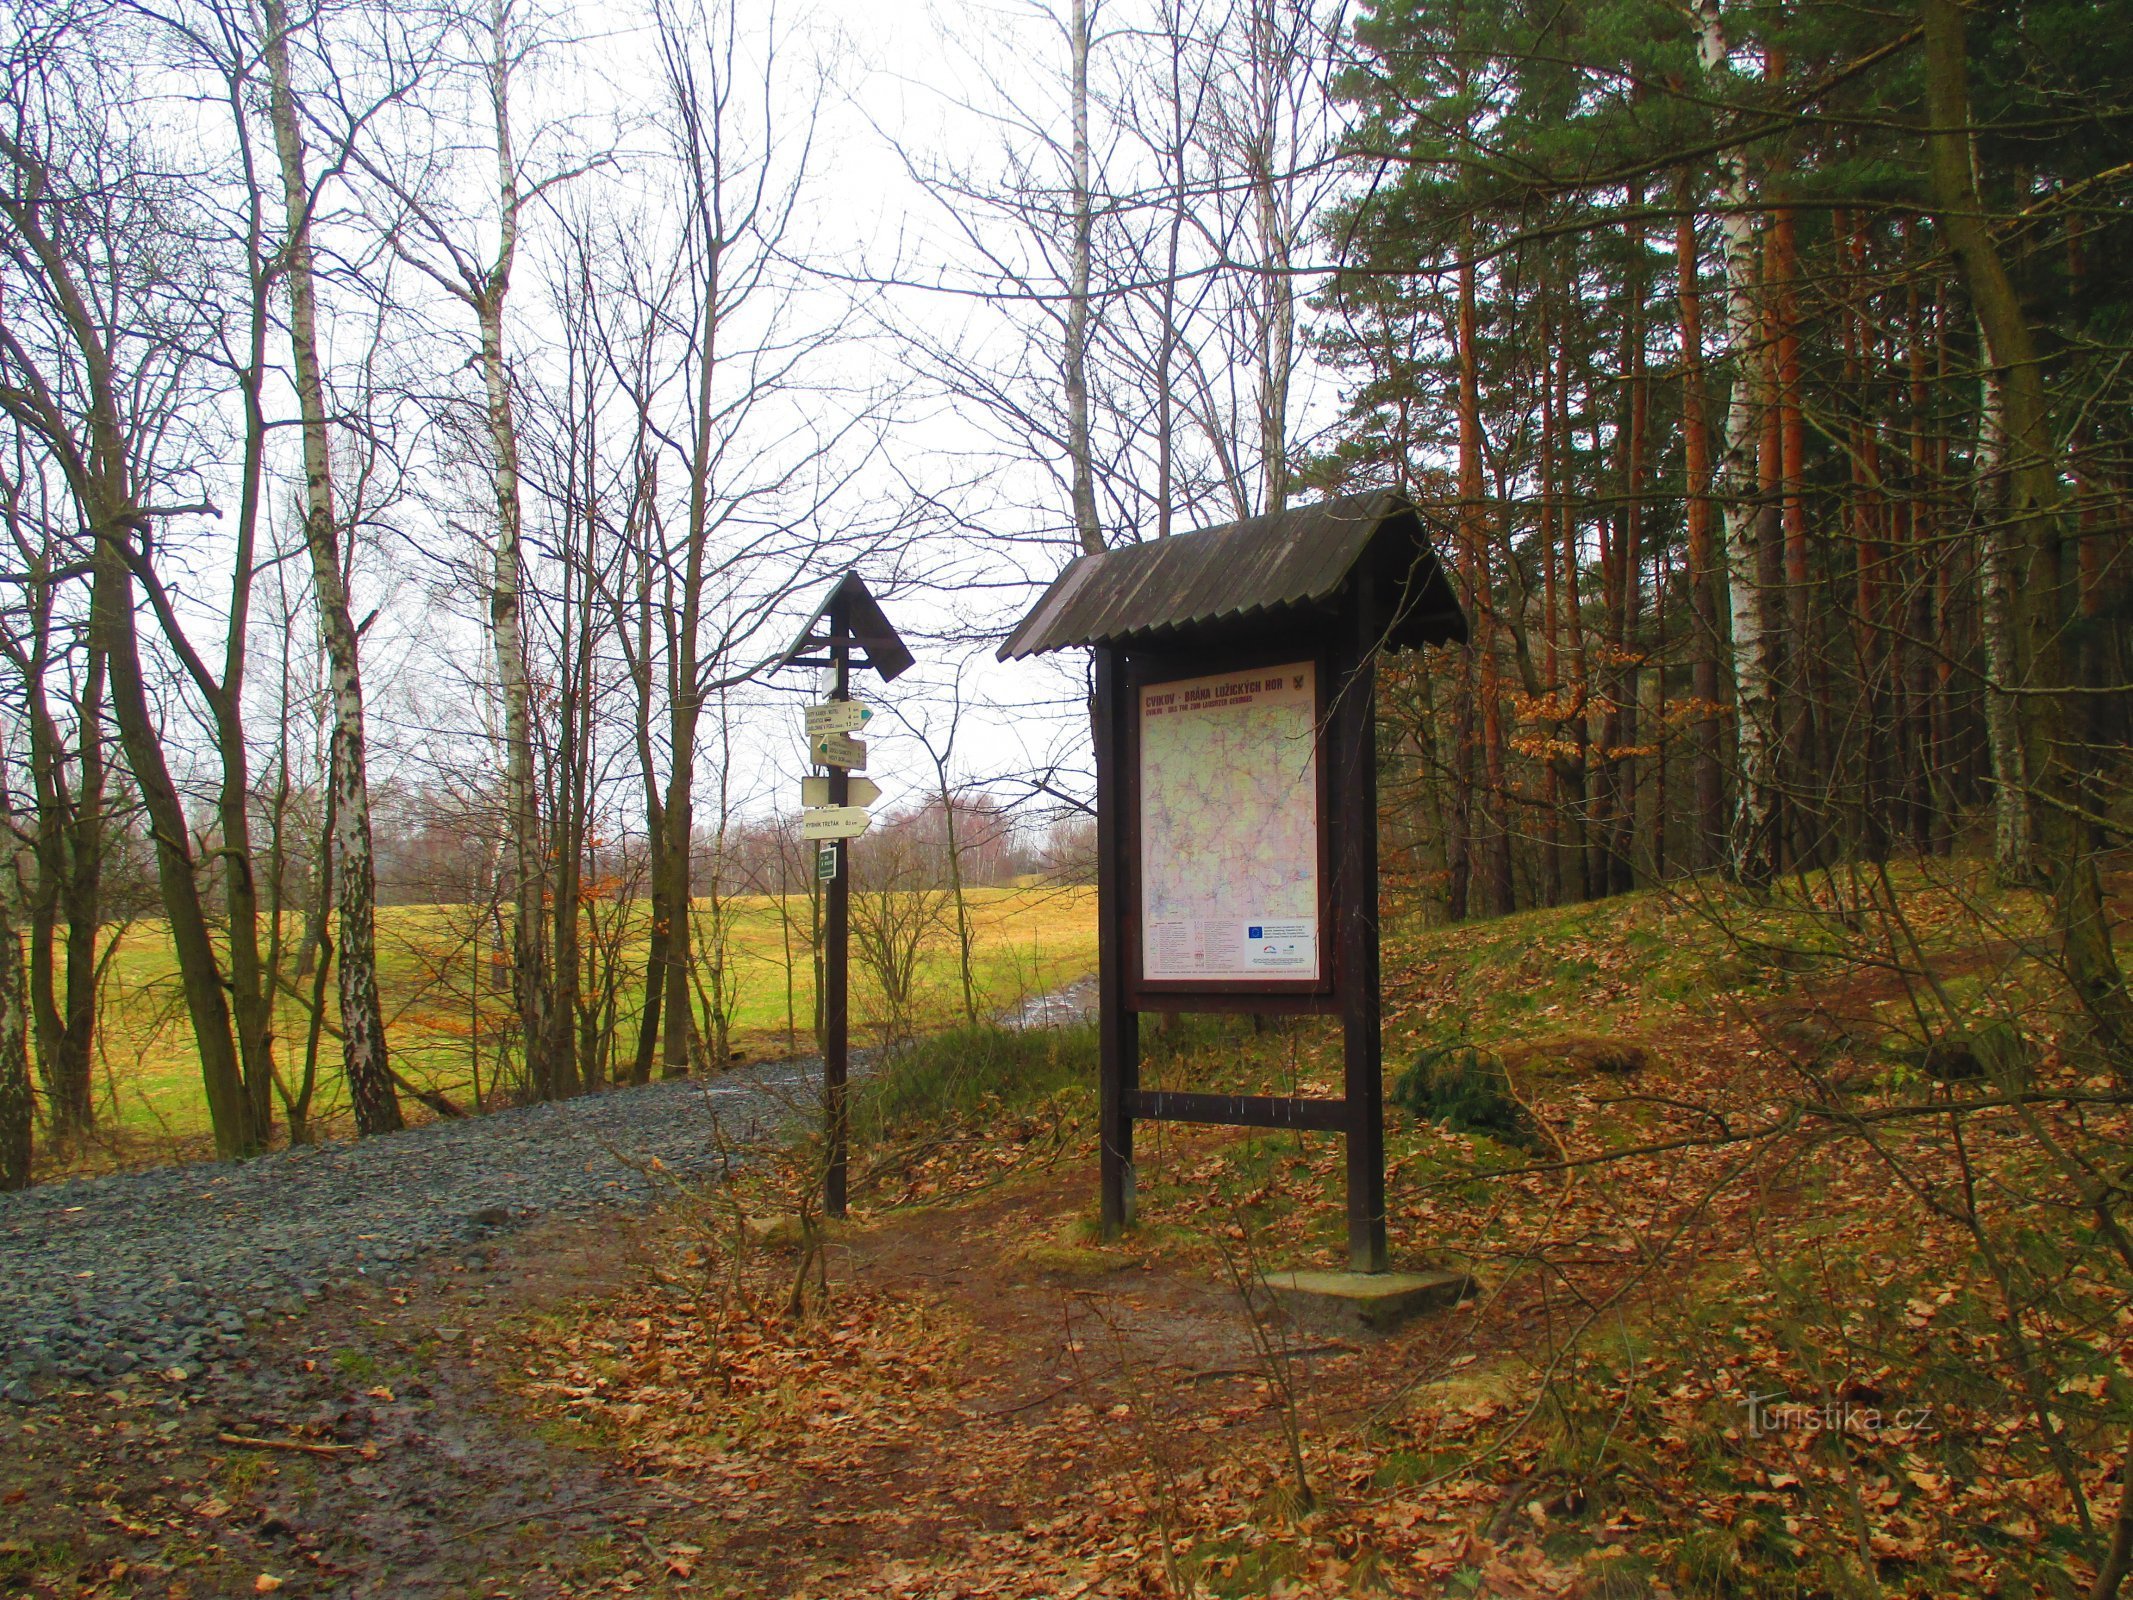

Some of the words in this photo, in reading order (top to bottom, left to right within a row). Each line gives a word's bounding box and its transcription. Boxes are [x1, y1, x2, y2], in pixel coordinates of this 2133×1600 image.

[1146, 693, 1175, 708] CVIKOV
[1184, 685, 1211, 703] BRÁNA
[1215, 679, 1261, 698] LUŽICKÝCH
[1265, 677, 1283, 692] HOR
